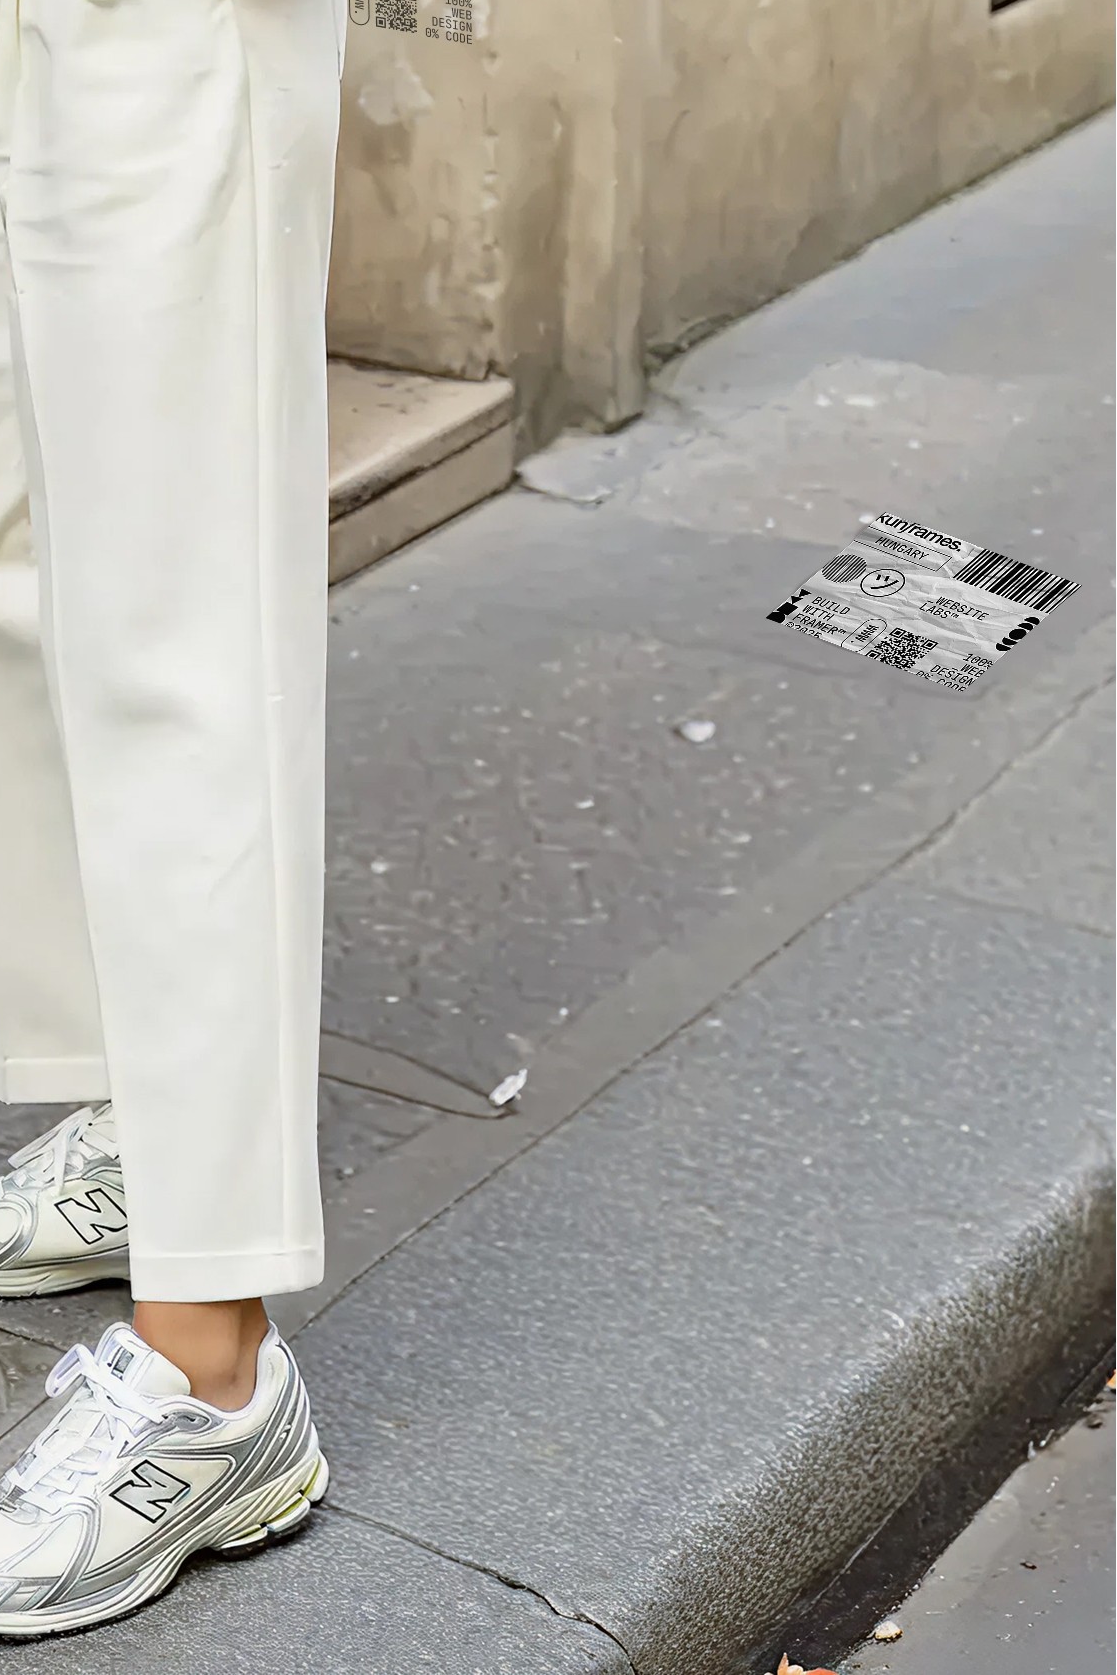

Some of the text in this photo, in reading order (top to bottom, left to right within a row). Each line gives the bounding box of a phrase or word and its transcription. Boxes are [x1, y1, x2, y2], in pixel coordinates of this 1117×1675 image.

[432, 16, 473, 32] DESIGN
[425, 27, 473, 45] 0% CODE
[875, 536, 929, 560] HUNGARY
[802, 604, 835, 621] WITH
[811, 596, 851, 615] BUILD
[792, 613, 846, 635] FRAMER™
[930, 664, 976, 686] DESIGN
[54, 1187, 129, 1245] N
[109, 1459, 191, 1524] N
